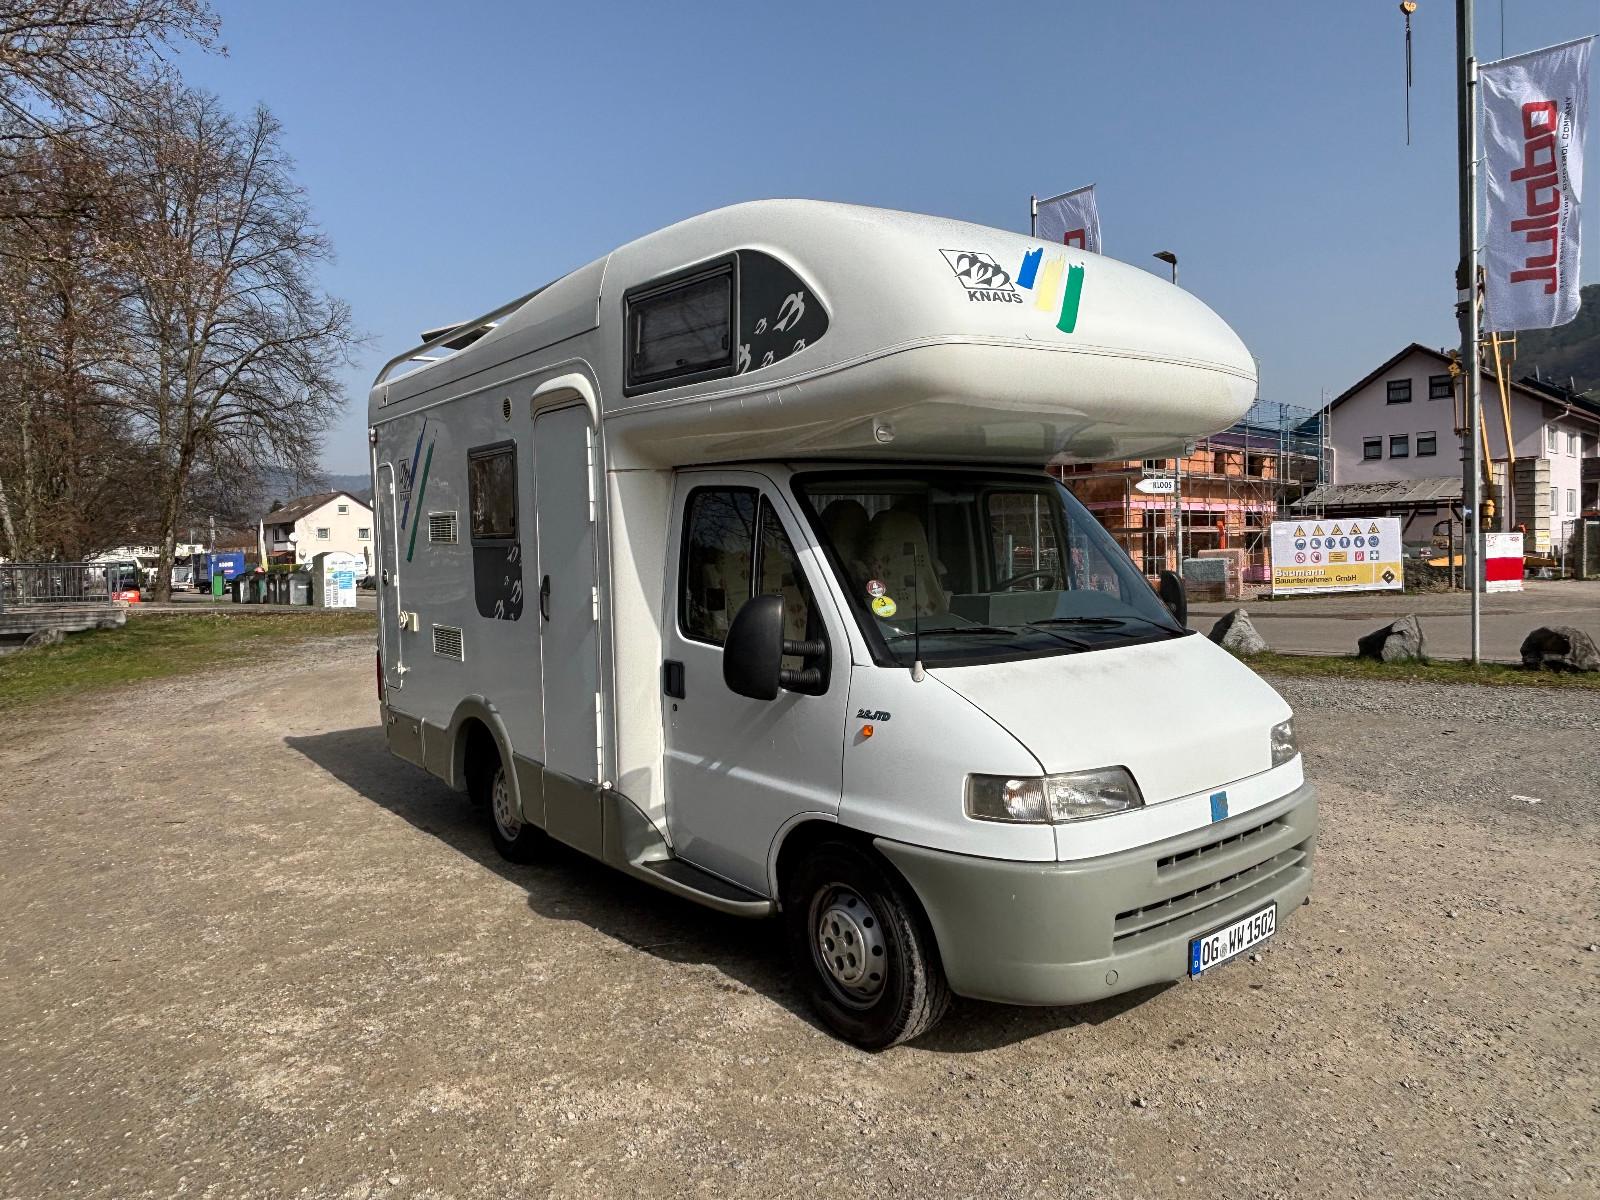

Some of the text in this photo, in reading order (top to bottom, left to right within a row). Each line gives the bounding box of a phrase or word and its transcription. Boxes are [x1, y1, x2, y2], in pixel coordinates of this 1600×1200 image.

[967, 290, 1023, 304] KNAUS
[1275, 568, 1326, 577] Baumann
[1274, 574, 1357, 585] Bauunternehmen GmbH
[1202, 909, 1274, 966] OG WW 1502
